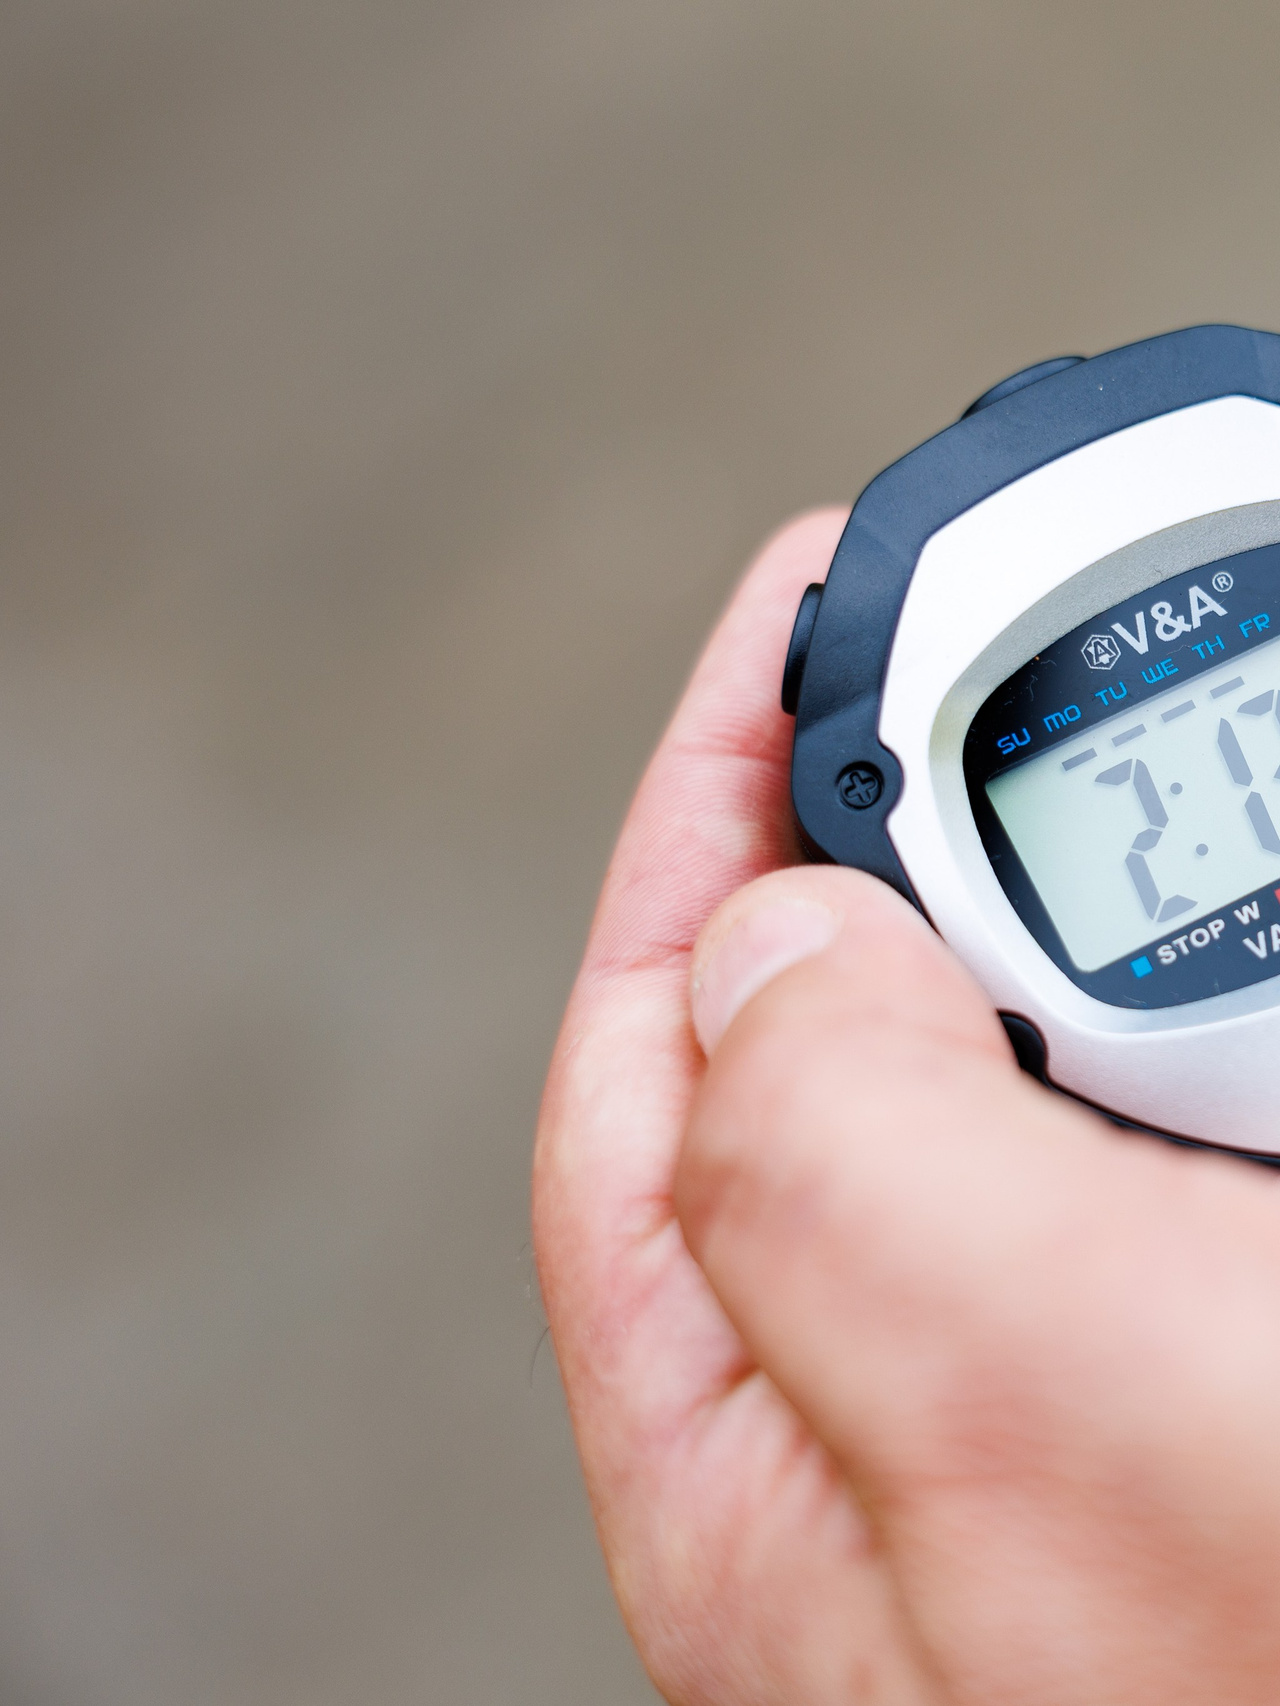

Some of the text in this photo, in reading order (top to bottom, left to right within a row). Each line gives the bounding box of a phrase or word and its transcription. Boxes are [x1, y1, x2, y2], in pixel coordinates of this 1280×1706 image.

[997, 727, 1031, 755] SU
[1095, 682, 1128, 706] TU
[1141, 658, 1179, 684] WE
[1192, 635, 1225, 660] TH
[1239, 613, 1271, 638] FR
[1156, 918, 1226, 965] STOP
[1234, 901, 1260, 926] W
